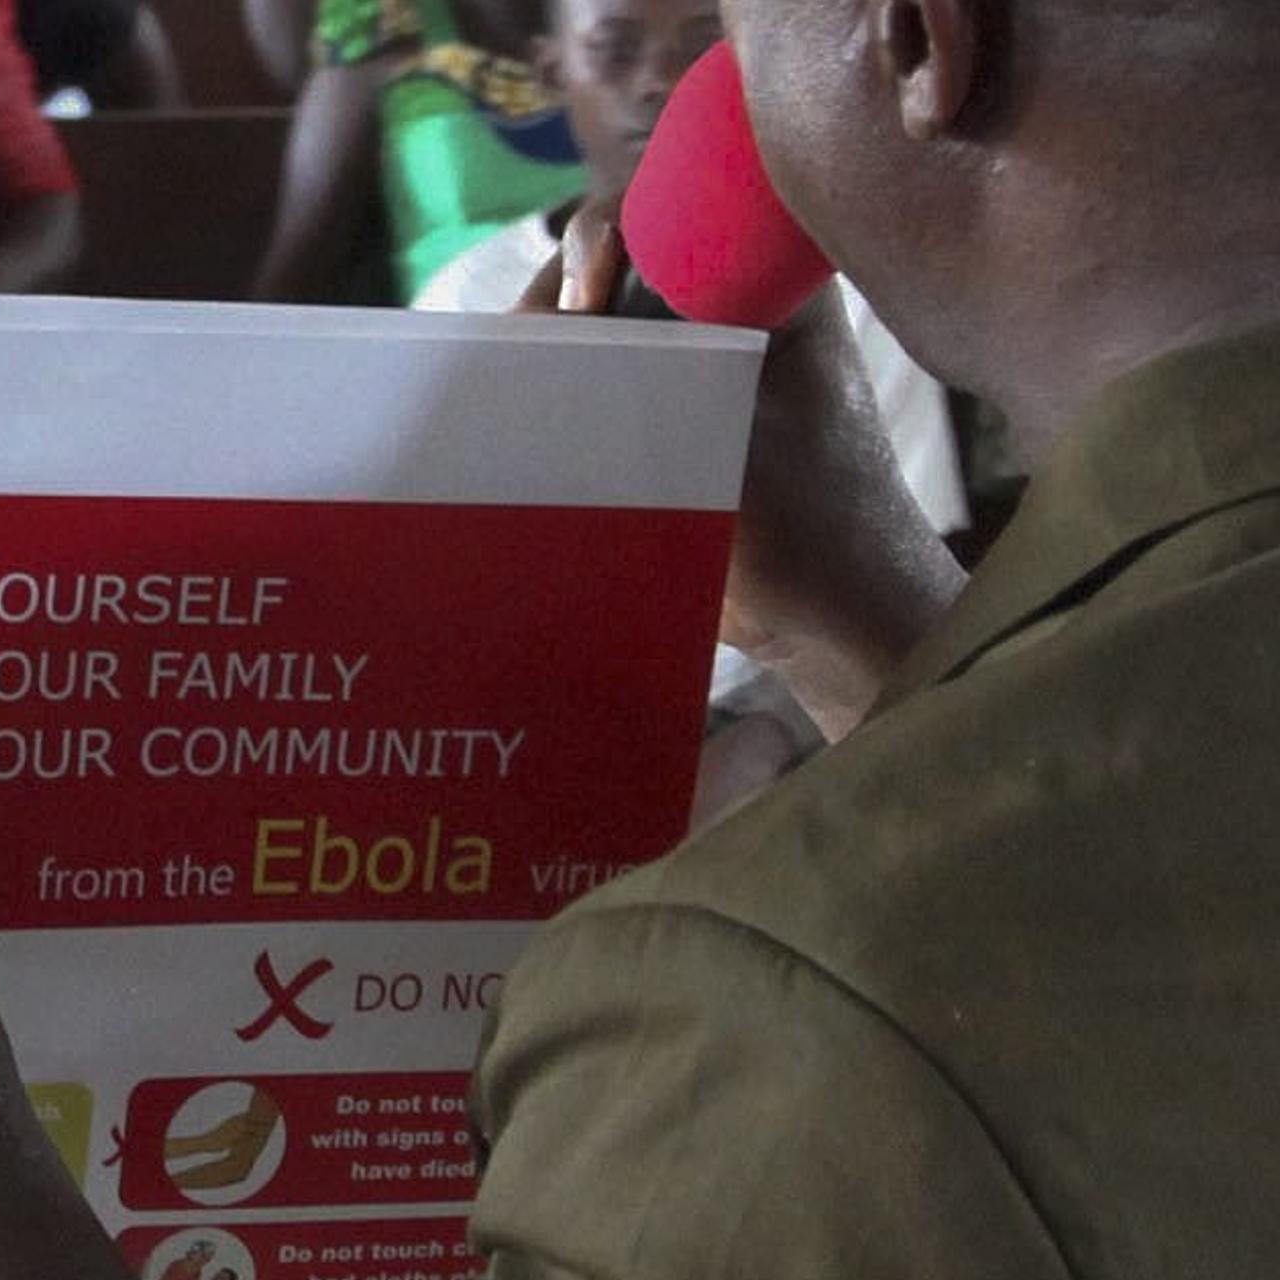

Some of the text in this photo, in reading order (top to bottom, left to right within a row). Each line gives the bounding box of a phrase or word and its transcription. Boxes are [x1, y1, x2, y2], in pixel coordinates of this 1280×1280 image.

[147, 651, 370, 702] FAMILY
[140, 726, 525, 778] COMMUNITY
[37, 855, 146, 901] from
[161, 854, 235, 899] the
[252, 816, 493, 895] Ebola
[354, 972, 504, 1013] DO NO
[336, 1095, 370, 1115] Do
[379, 1095, 422, 1115] not
[311, 1128, 368, 1150] with
[376, 1126, 445, 1152] signs
[350, 1158, 478, 1182] have died
[278, 1243, 313, 1264] Do
[322, 1243, 365, 1262] not
[371, 1241, 444, 1261] touch
